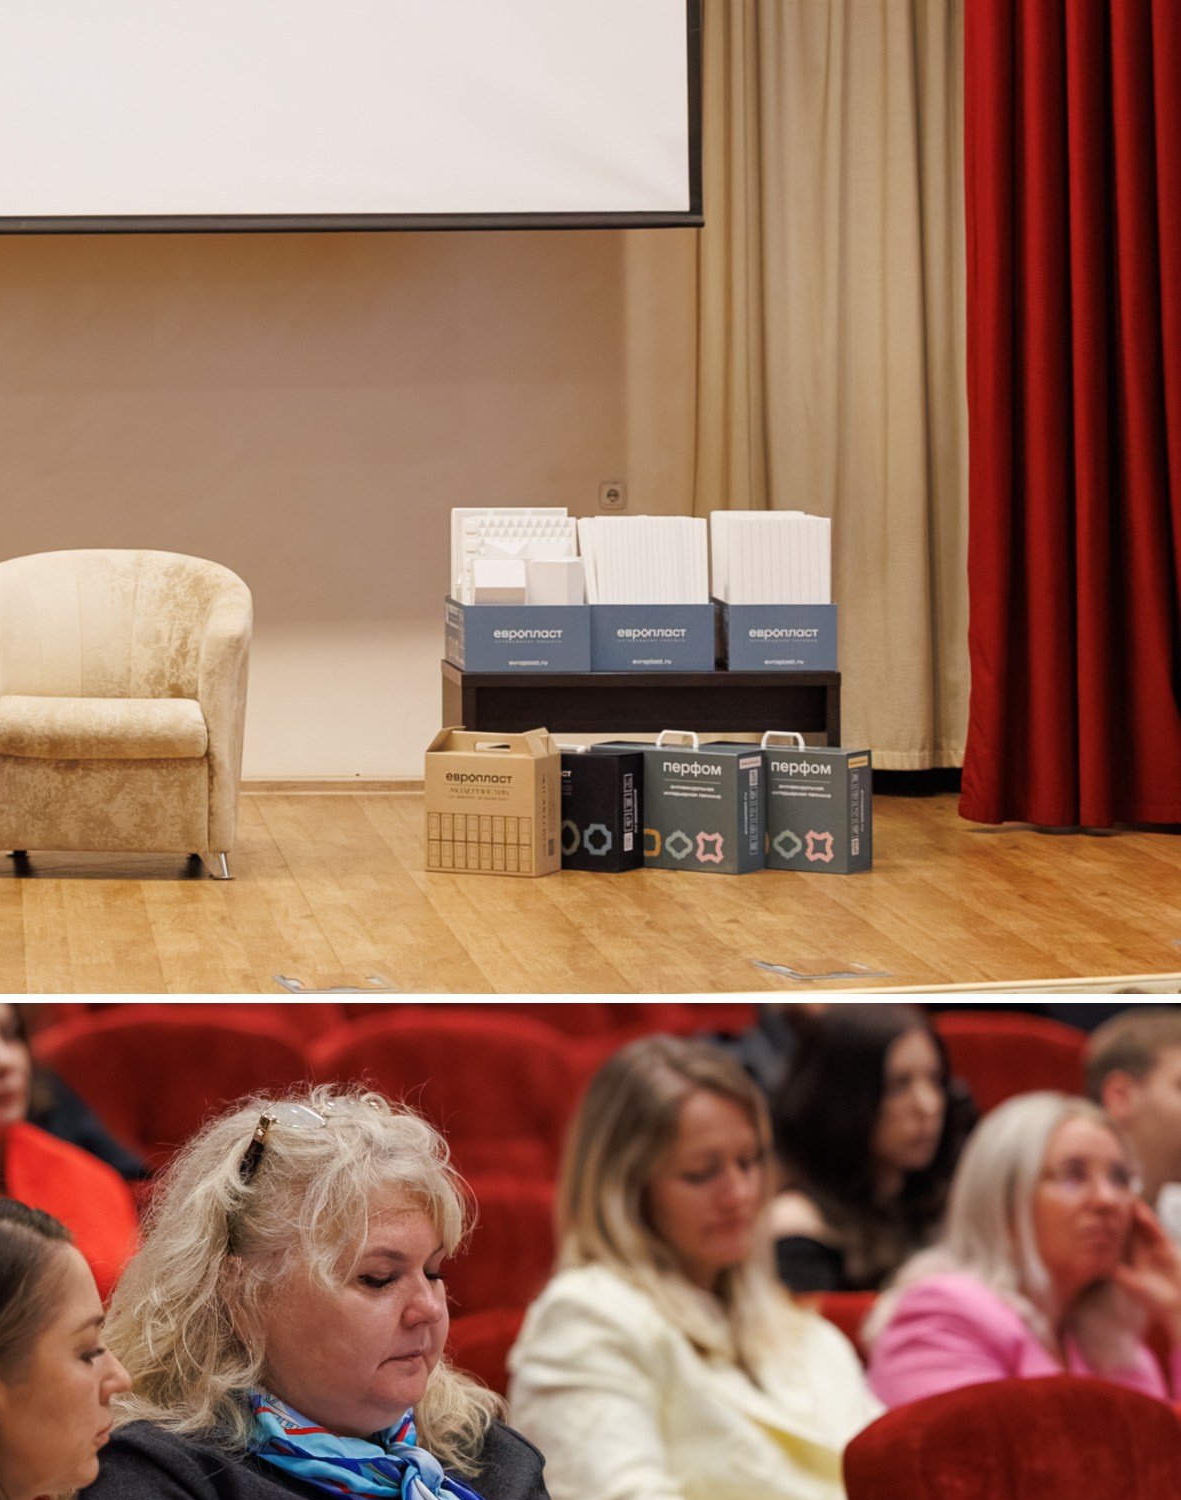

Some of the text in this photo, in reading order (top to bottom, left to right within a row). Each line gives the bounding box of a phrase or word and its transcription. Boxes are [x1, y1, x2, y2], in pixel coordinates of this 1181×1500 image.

[493, 629, 563, 641] европласт
[616, 628, 688, 640] европласт
[748, 628, 819, 640] европласт
[663, 761, 722, 777] перфом
[771, 760, 831, 776] перфом
[445, 772, 513, 784] европласт
